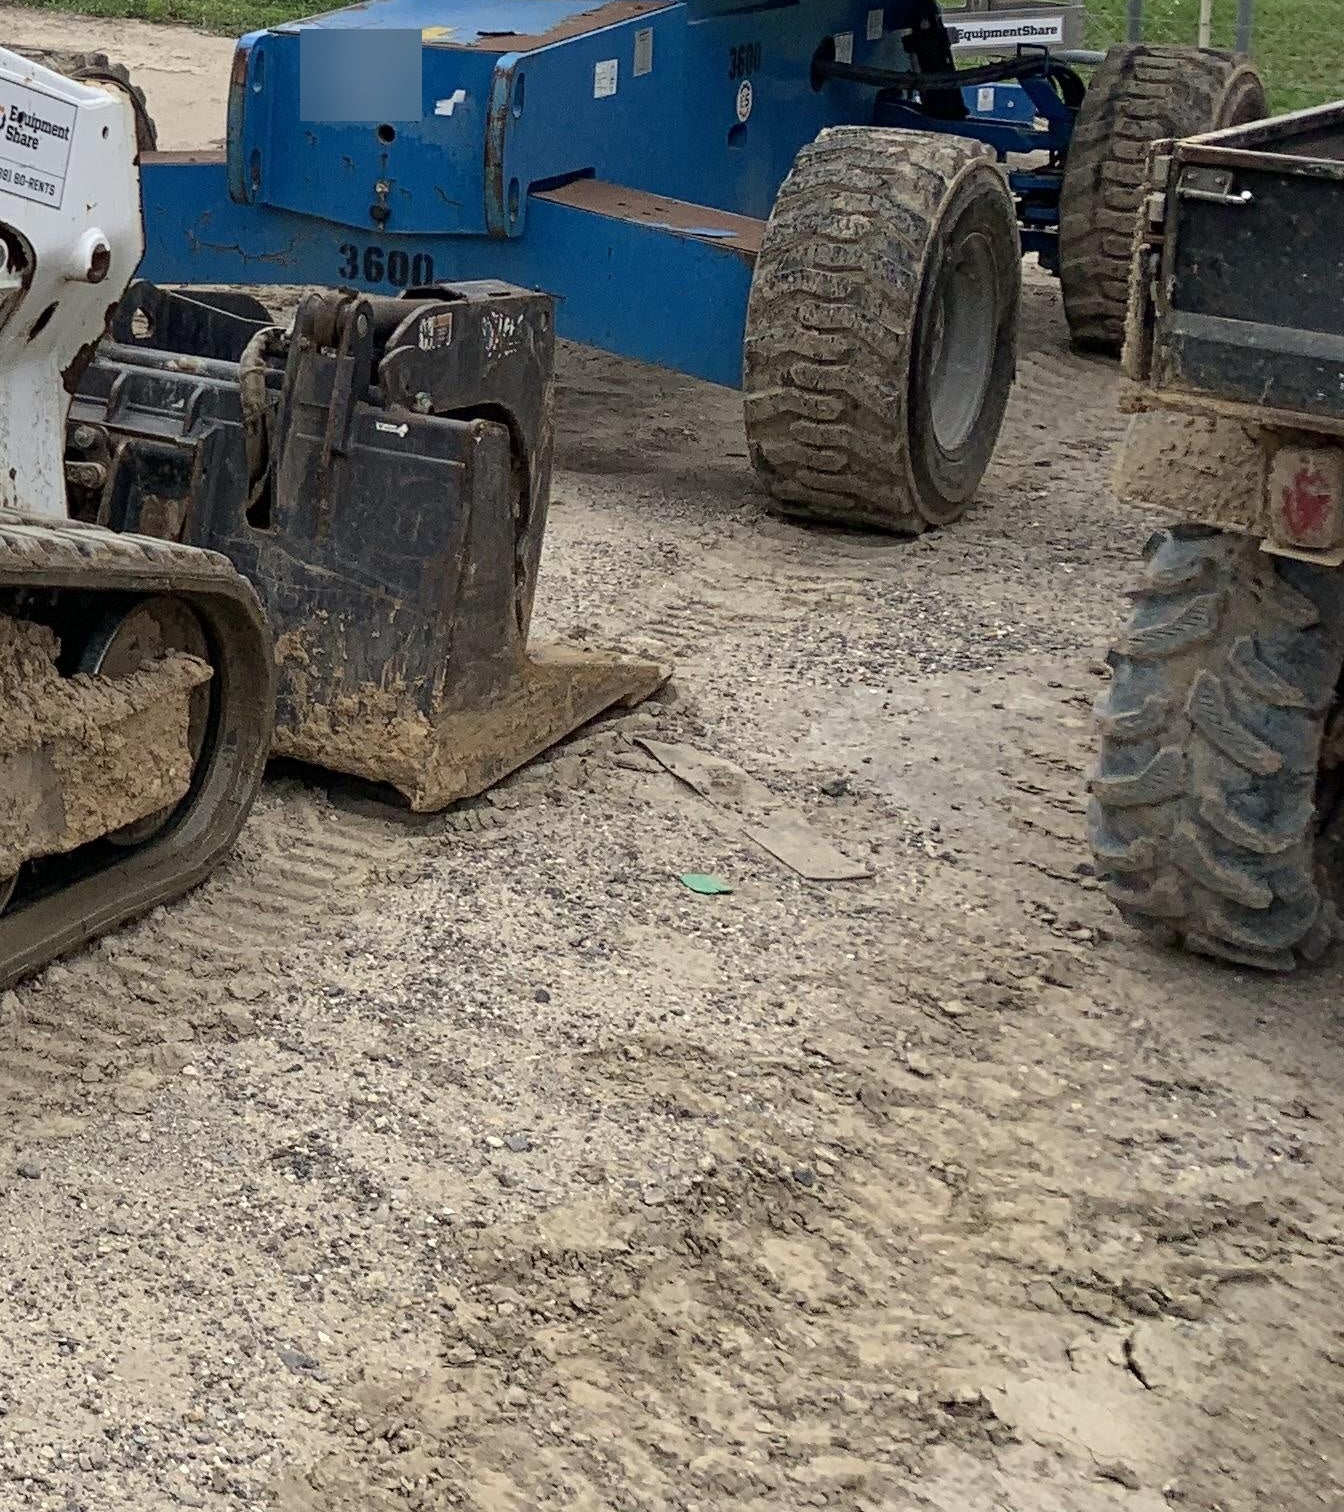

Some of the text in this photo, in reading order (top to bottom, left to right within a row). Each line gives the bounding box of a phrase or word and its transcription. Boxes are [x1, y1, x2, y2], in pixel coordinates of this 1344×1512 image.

[957, 25, 1058, 42] EquipmentShare
[5, 124, 39, 150] Share
[9, 104, 70, 141] Equipment
[338, 243, 434, 287] 3600
